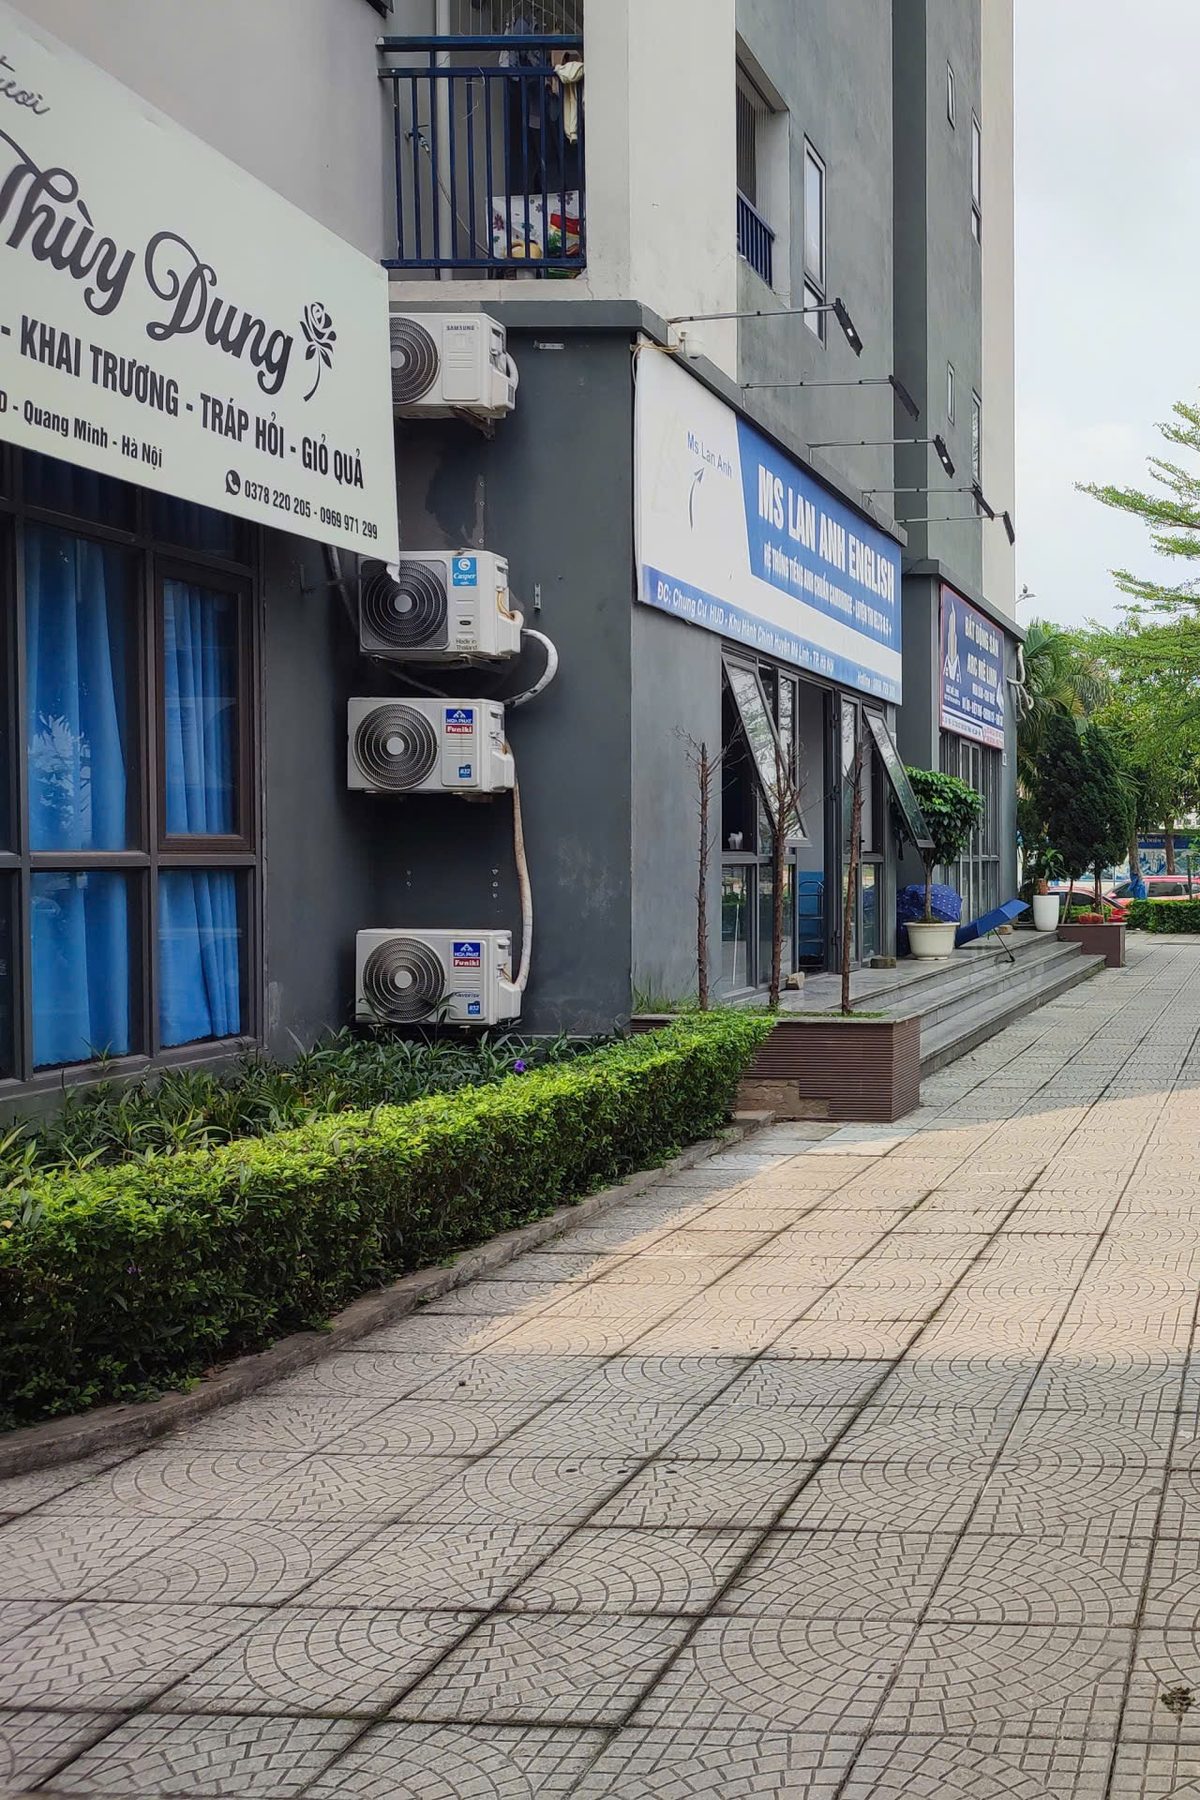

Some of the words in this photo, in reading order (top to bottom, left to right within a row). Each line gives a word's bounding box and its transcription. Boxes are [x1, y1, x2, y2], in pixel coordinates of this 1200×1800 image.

[145, 231, 294, 395] Dung
[20, 314, 81, 378] KHAI
[89, 343, 179, 417] TRƯƠNG
[200, 392, 249, 442] TRÁP
[255, 411, 284, 458] HỎI
[302, 433, 329, 475] GIỎ
[333, 448, 364, 489] QUẢ
[24, 400, 69, 437] Quang
[74, 418, 108, 449] Minh
[121, 434, 138, 459] Hà
[142, 442, 162, 470] Nội
[687, 431, 699, 452] Ms
[701, 444, 716, 464] Lan
[717, 453, 733, 479] Anh
[244, 480, 270, 504] 0378
[272, 490, 291, 511] 220
[293, 498, 311, 518] 205
[320, 506, 342, 528] 0969
[344, 514, 359, 534] 971
[362, 520, 378, 540] 299
[758, 463, 784, 530] MS
[788, 486, 816, 552] LAN
[819, 511, 846, 573] ANH
[848, 532, 895, 606] ENGLISH
[673, 588, 696, 617] Chung
[709, 604, 724, 625] HUD
[728, 613, 740, 632] Khu
